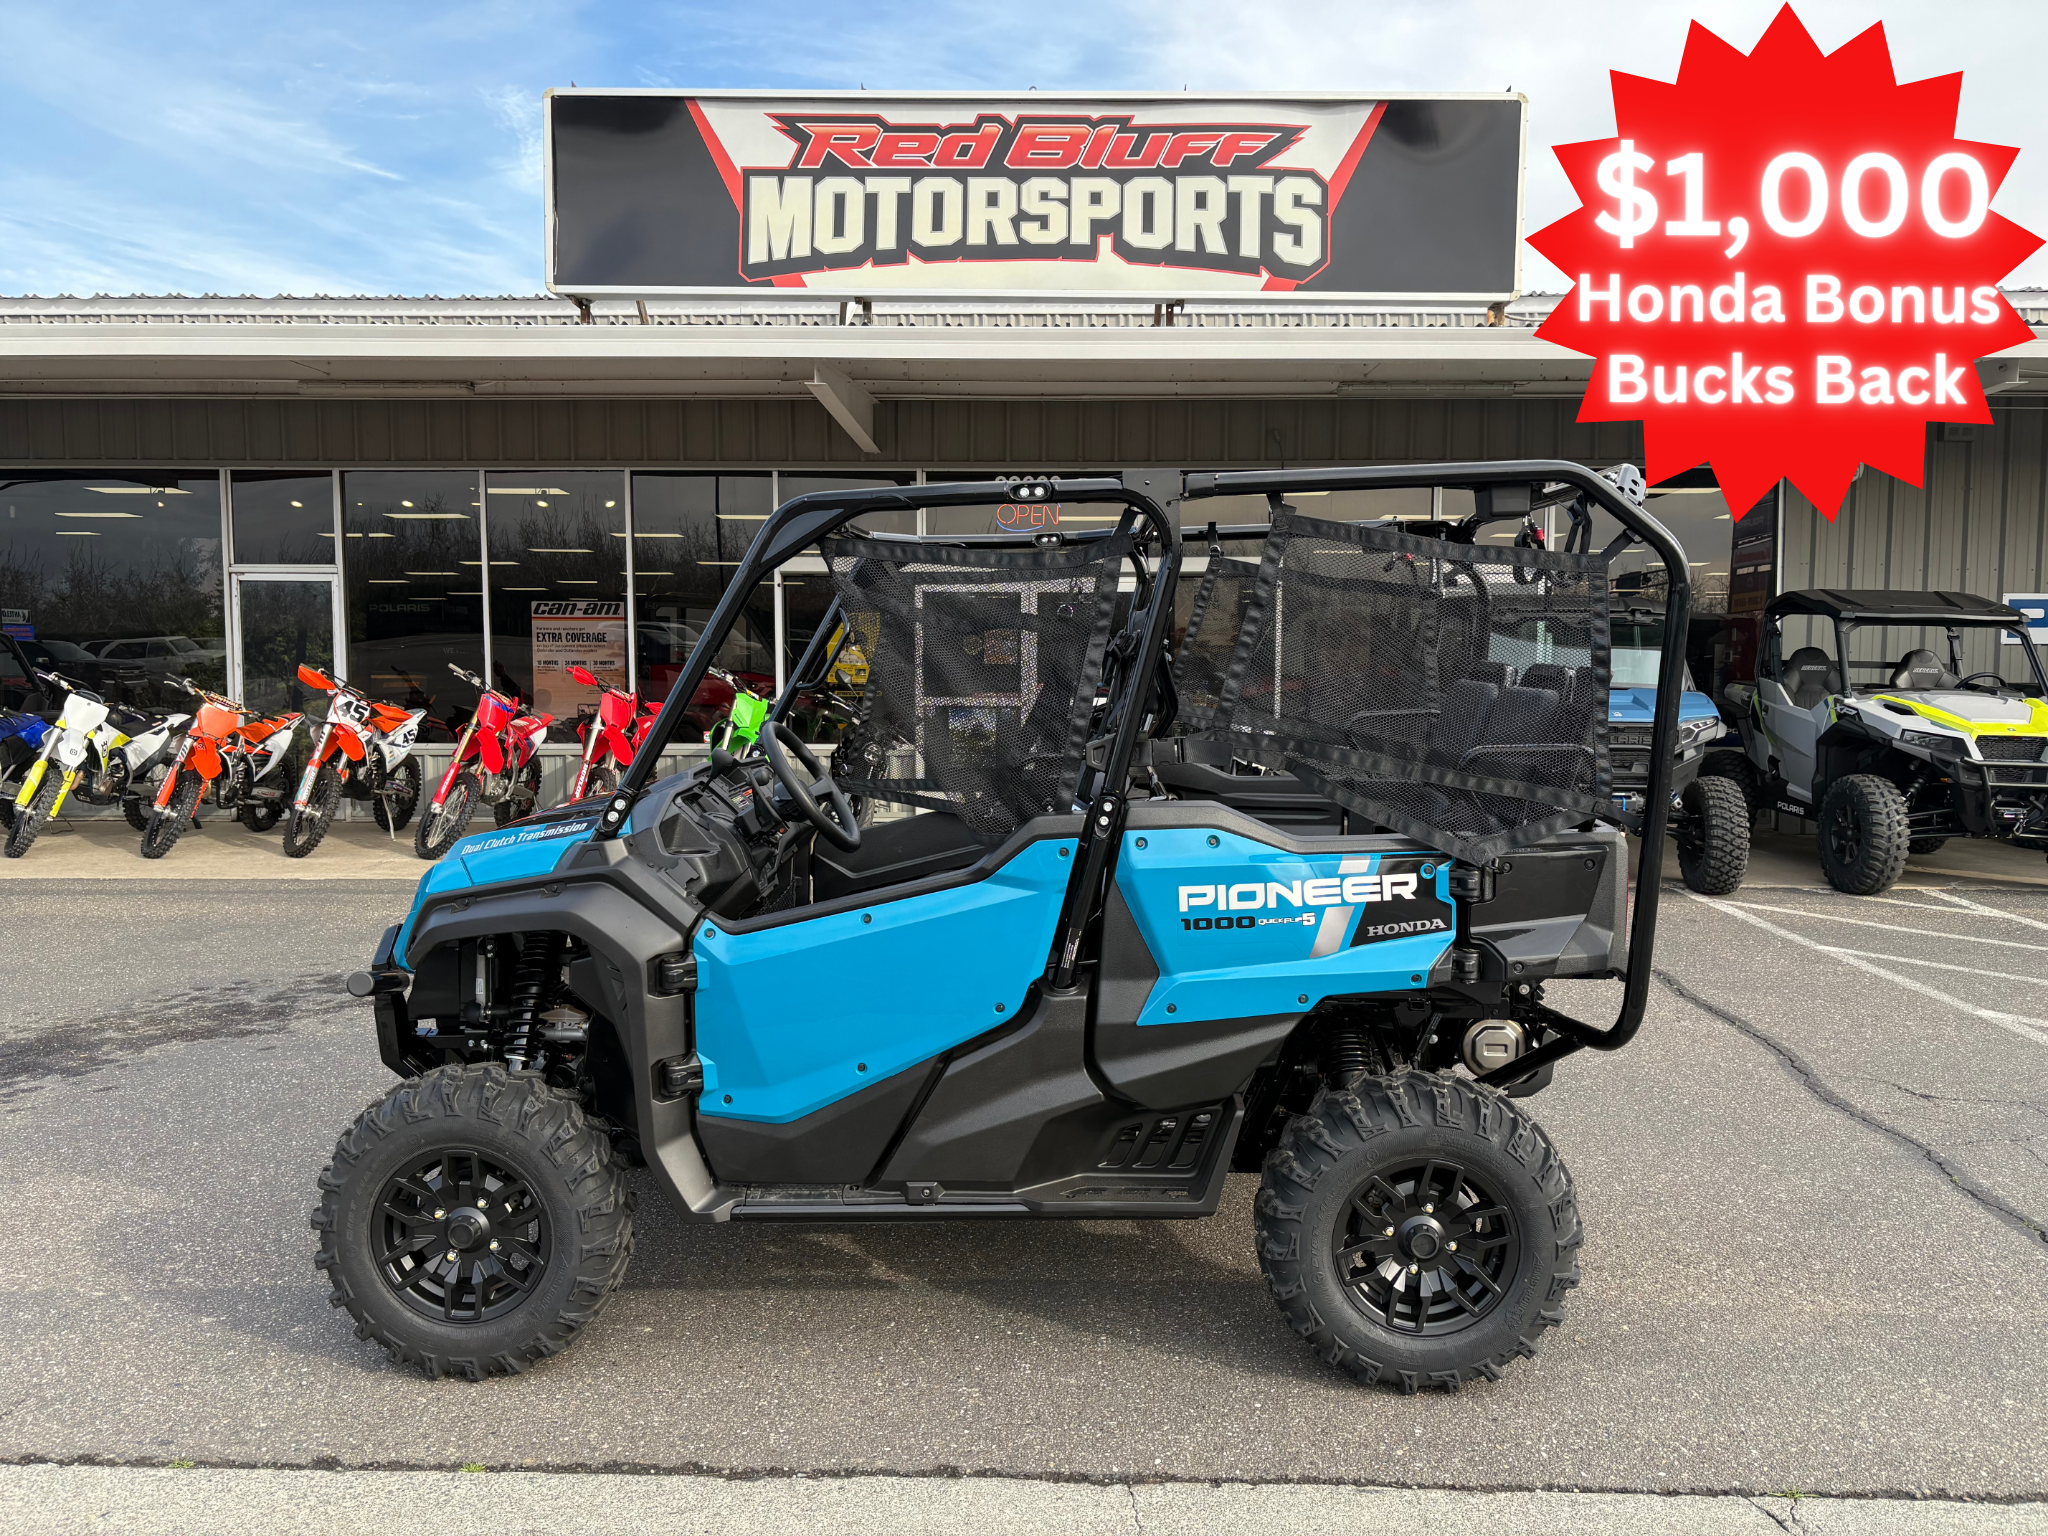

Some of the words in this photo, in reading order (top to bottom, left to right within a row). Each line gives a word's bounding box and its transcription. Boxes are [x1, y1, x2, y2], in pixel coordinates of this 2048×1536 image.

[798, 122, 1001, 169] Red
[748, 175, 1323, 267] MOTORSPORTS
[997, 503, 1060, 526] OPEN
[369, 603, 431, 613] POLARIS
[536, 632, 564, 643] EXTRA
[565, 632, 608, 643] COVERAGE
[342, 700, 368, 722] 45
[1776, 800, 1805, 815] POLARIS
[461, 843, 483, 855] Dual
[483, 834, 517, 850] Clutch
[517, 821, 588, 843] Transmission
[1178, 873, 1418, 912] PIONEER
[1180, 915, 1256, 931] 1000
[1366, 917, 1448, 937] HONDA
